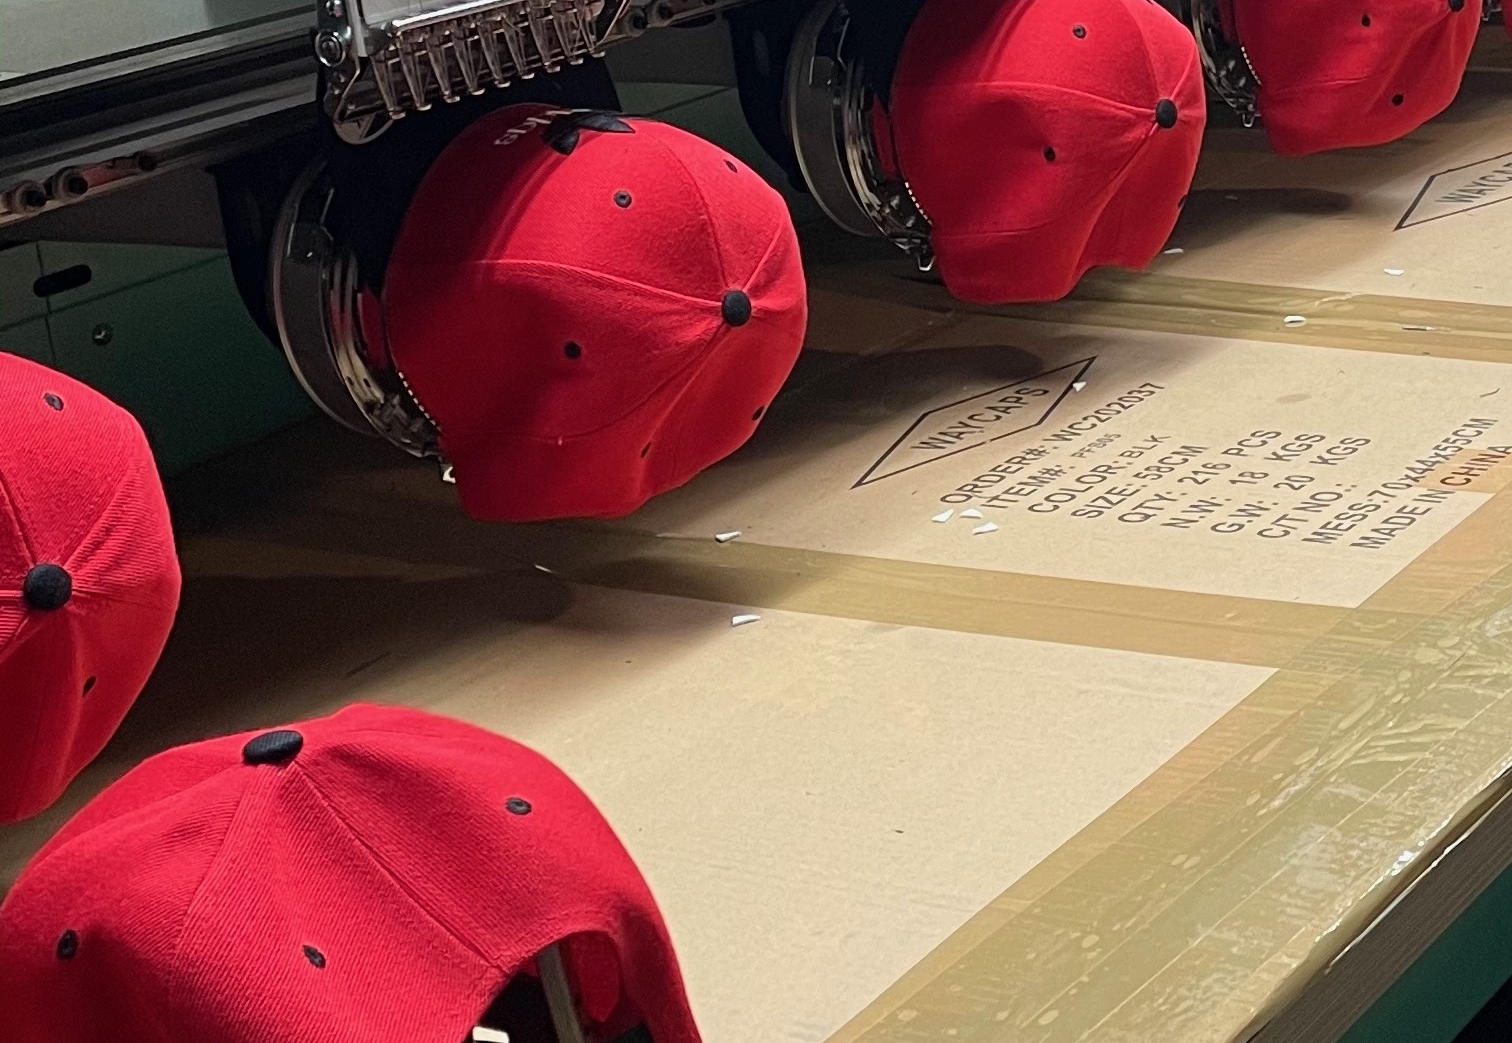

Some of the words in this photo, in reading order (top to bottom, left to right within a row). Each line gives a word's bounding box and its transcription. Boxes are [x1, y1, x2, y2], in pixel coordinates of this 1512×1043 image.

[910, 387, 1050, 451] WAYCAPS
[940, 445, 1058, 504] ORDER#:
[1043, 382, 1165, 442] WC202037
[1028, 460, 1133, 513] COLOR:
[1119, 434, 1172, 458] BLK
[1071, 483, 1148, 519] SIZE:
[1133, 445, 1210, 481] 58CM
[1117, 491, 1188, 523] QTY:
[1177, 462, 1231, 485] 216
[1221, 430, 1282, 456] PCS
[1229, 471, 1269, 485] 18
[1264, 433, 1326, 462] KGS
[1273, 474, 1315, 491] 20
[1309, 437, 1371, 466] KGS
[1256, 514, 1309, 539] C/T
[1350, 505, 1432, 550] MADE
[1412, 488, 1456, 503] IN
